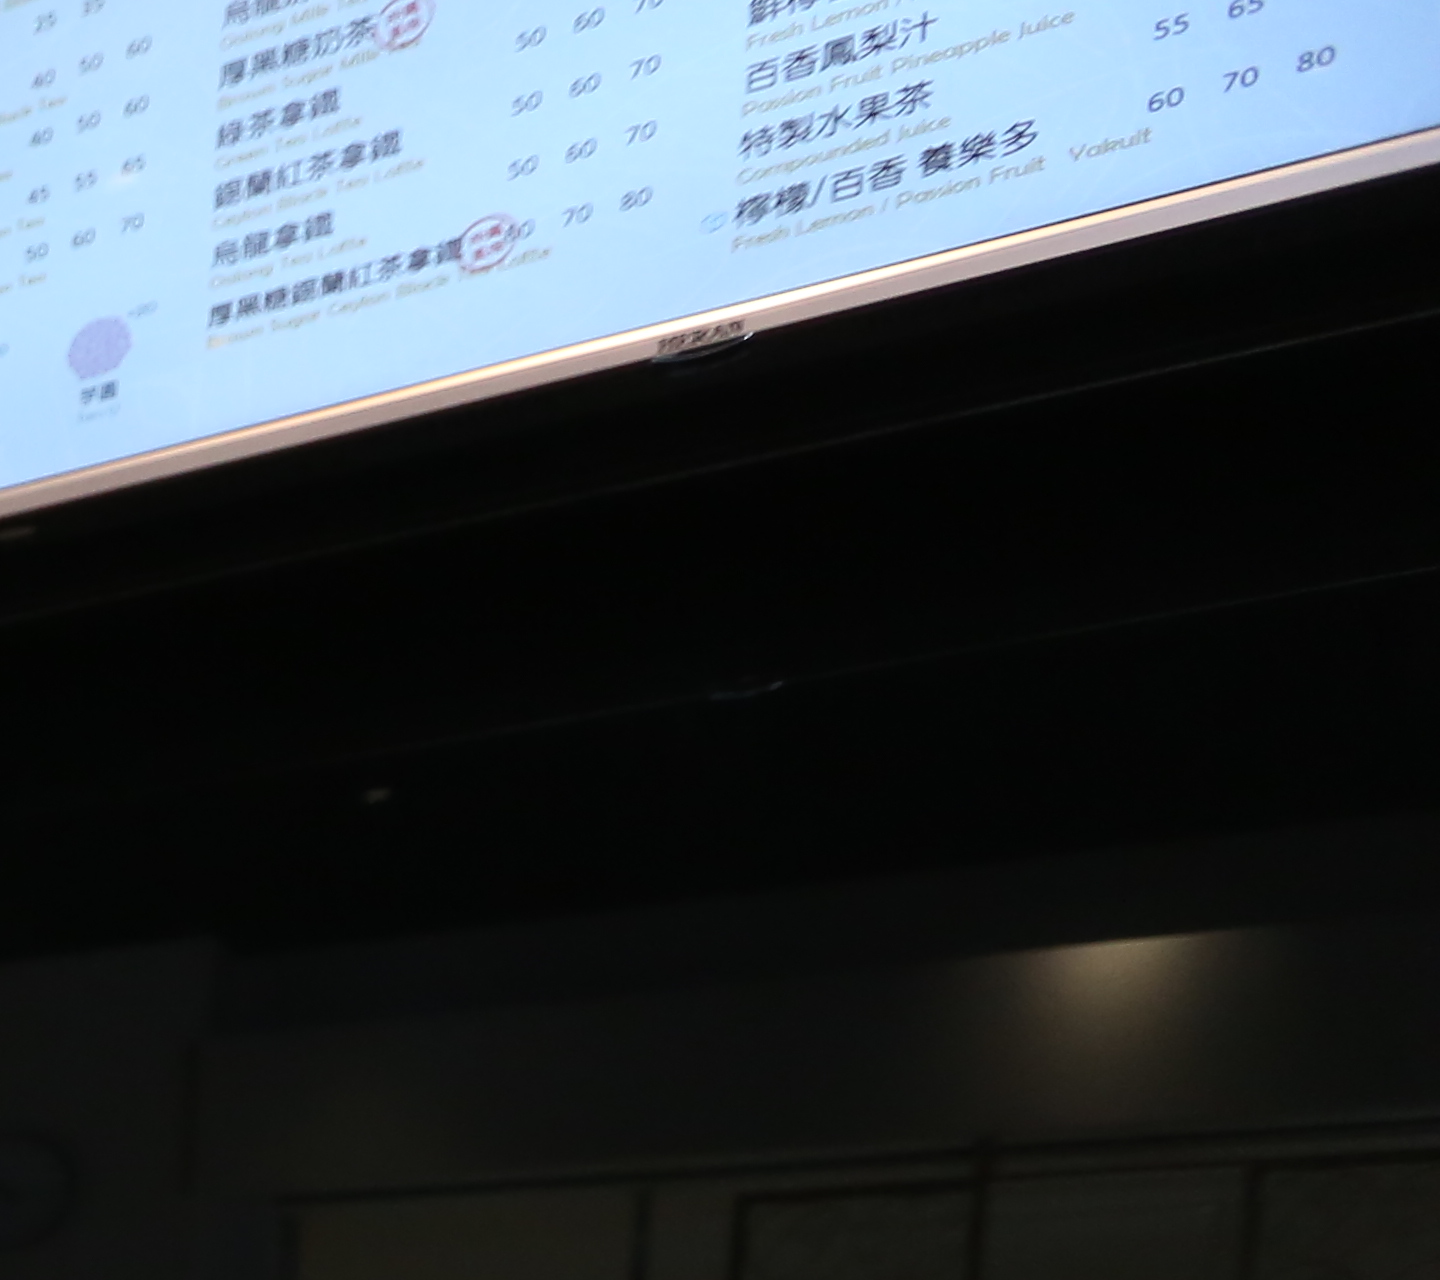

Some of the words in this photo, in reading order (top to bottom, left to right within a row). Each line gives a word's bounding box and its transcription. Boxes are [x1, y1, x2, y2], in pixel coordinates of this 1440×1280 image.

[515, 25, 548, 52] 50
[573, 7, 606, 34] 60
[745, 11, 939, 94] 百香鳳梨汁
[746, 23, 803, 51] Fresh
[811, 0, 888, 31] Lemon
[830, 63, 883, 98] Fruit
[890, 30, 1012, 76] Pineapple
[1019, 10, 1076, 40] Juice
[1153, 13, 1190, 41] 55
[511, 90, 543, 118] 50
[568, 72, 603, 99] 60
[629, 53, 663, 80] 70
[1147, 86, 1185, 112] 60
[1223, 66, 1260, 93] 70
[1296, 46, 1337, 73] 80
[507, 154, 540, 181] 50
[564, 137, 598, 164] 60
[624, 119, 658, 147] 70
[736, 132, 891, 185] Compounded
[897, 115, 952, 142] Juice
[738, 79, 934, 160] 特製水果茶
[917, 119, 1040, 178] 養樂多
[562, 203, 595, 228] 70
[619, 186, 654, 212] 80
[732, 225, 791, 253] Fresh
[795, 204, 875, 237] Lemon
[895, 177, 981, 210] Passion
[988, 156, 1047, 185] Fruit
